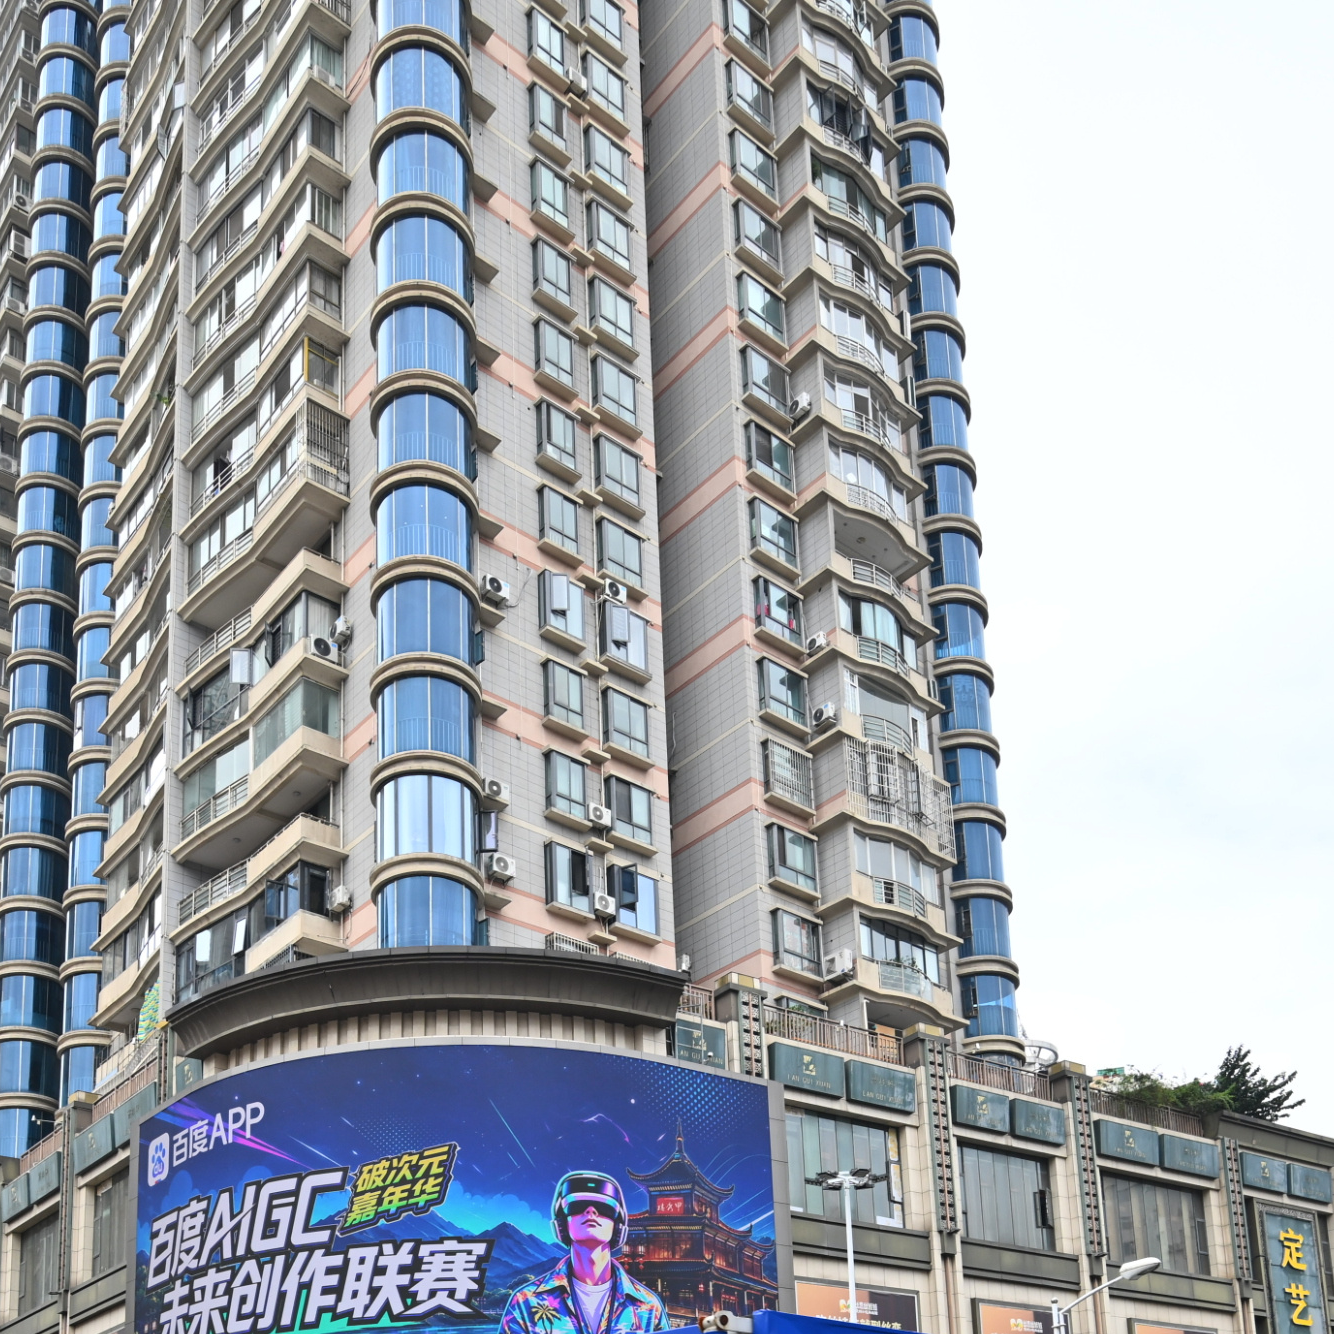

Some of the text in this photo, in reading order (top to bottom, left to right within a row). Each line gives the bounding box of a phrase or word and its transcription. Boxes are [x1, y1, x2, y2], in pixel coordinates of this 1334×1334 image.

[172, 1102, 265, 1167] 百度APP
[356, 1145, 450, 1192] 破次元
[148, 1171, 345, 1289] 百度AIGC
[344, 1177, 443, 1228] 嘉年华
